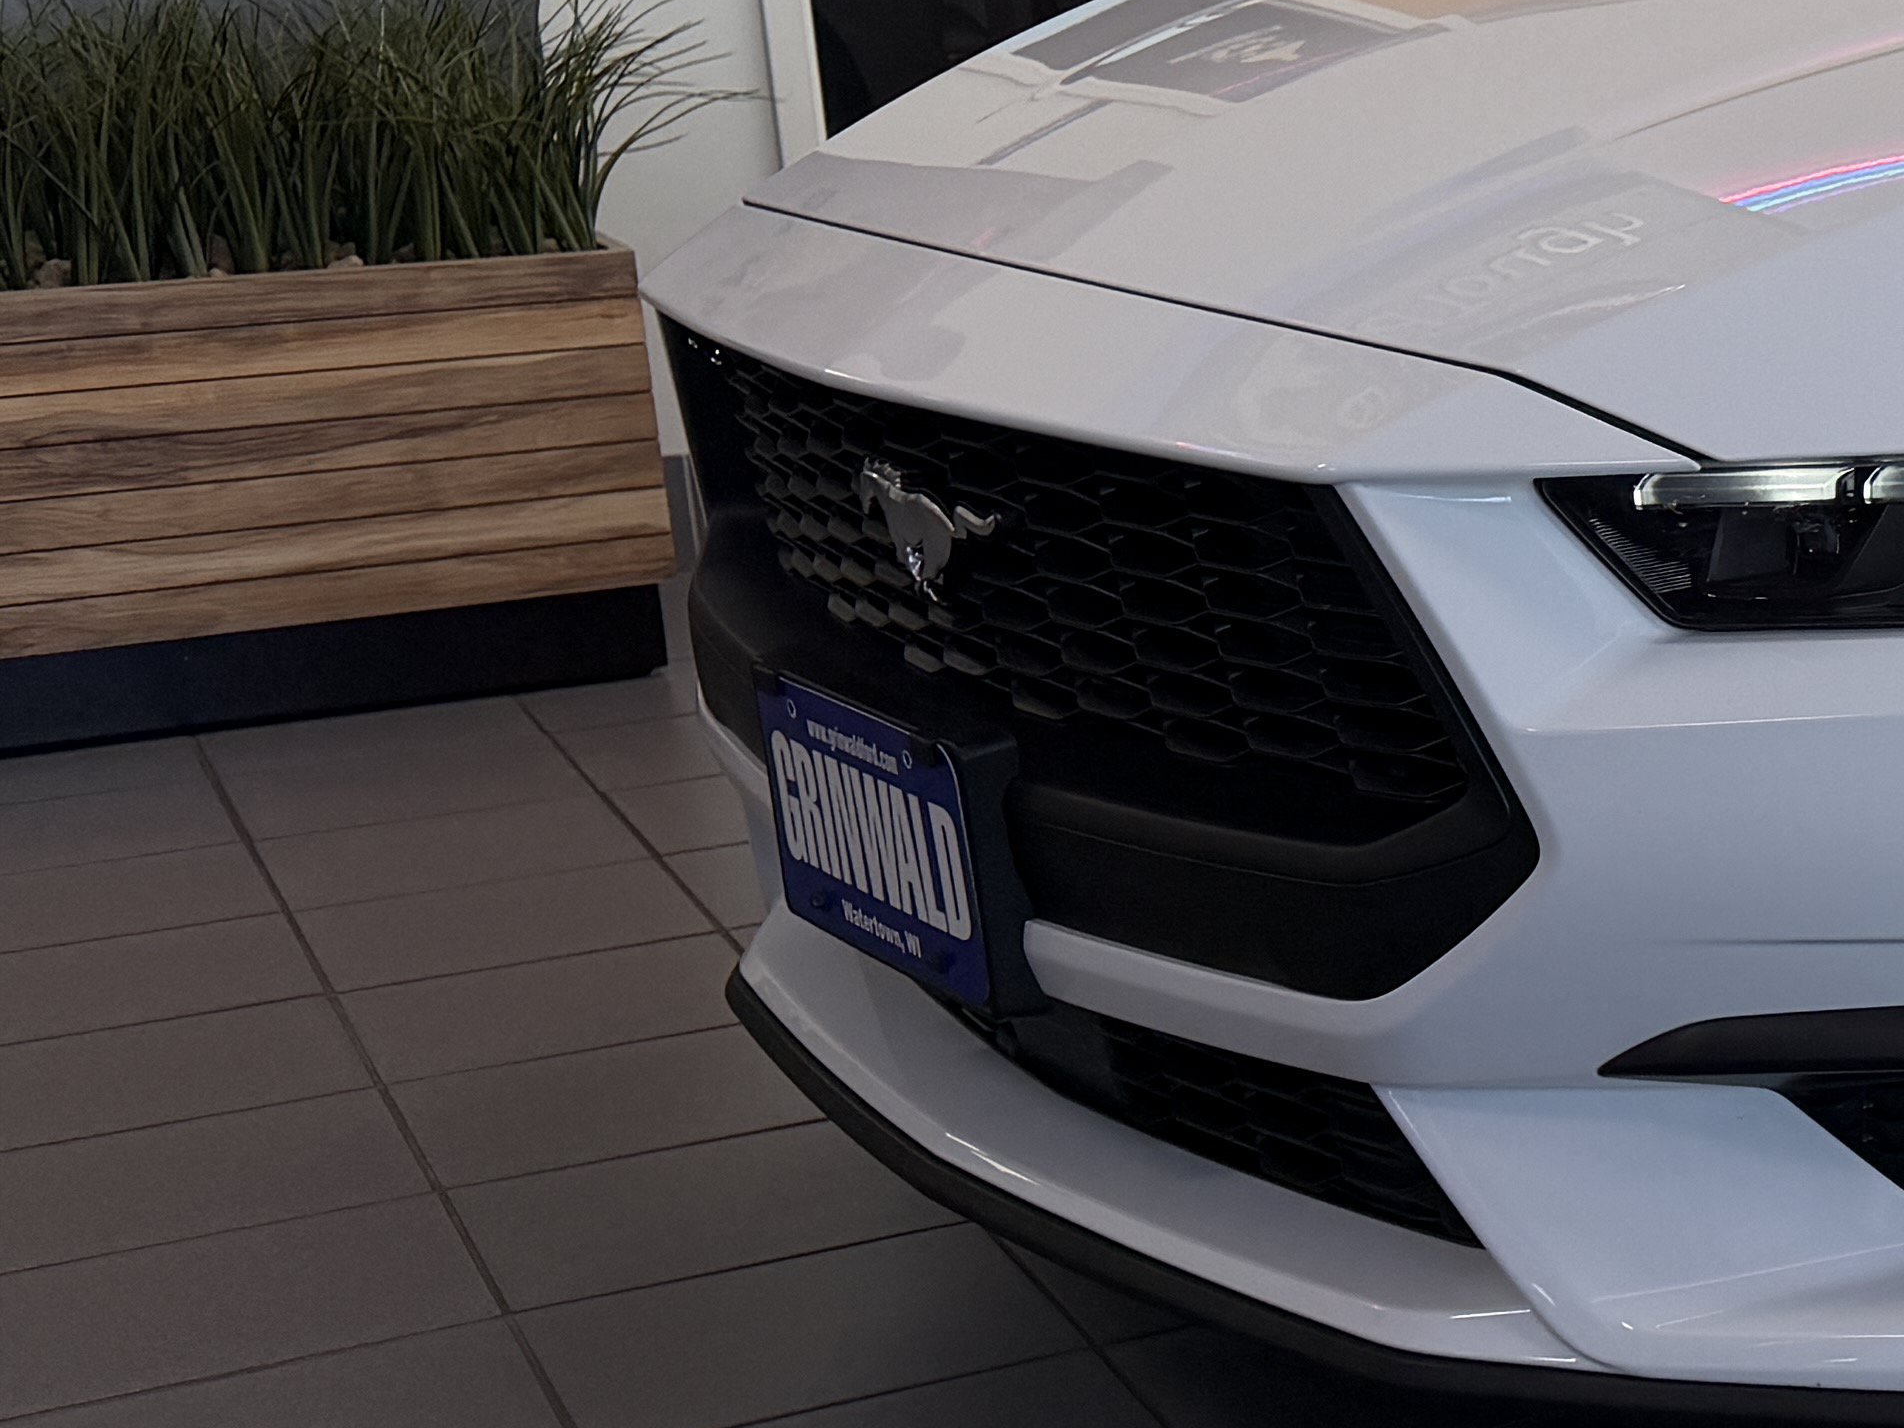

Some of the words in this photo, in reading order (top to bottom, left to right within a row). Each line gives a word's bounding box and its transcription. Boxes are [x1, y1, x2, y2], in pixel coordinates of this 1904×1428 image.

[771, 730, 972, 941] GRINWALD
[842, 899, 905, 954] Watertown,
[906, 932, 922, 959] WI
